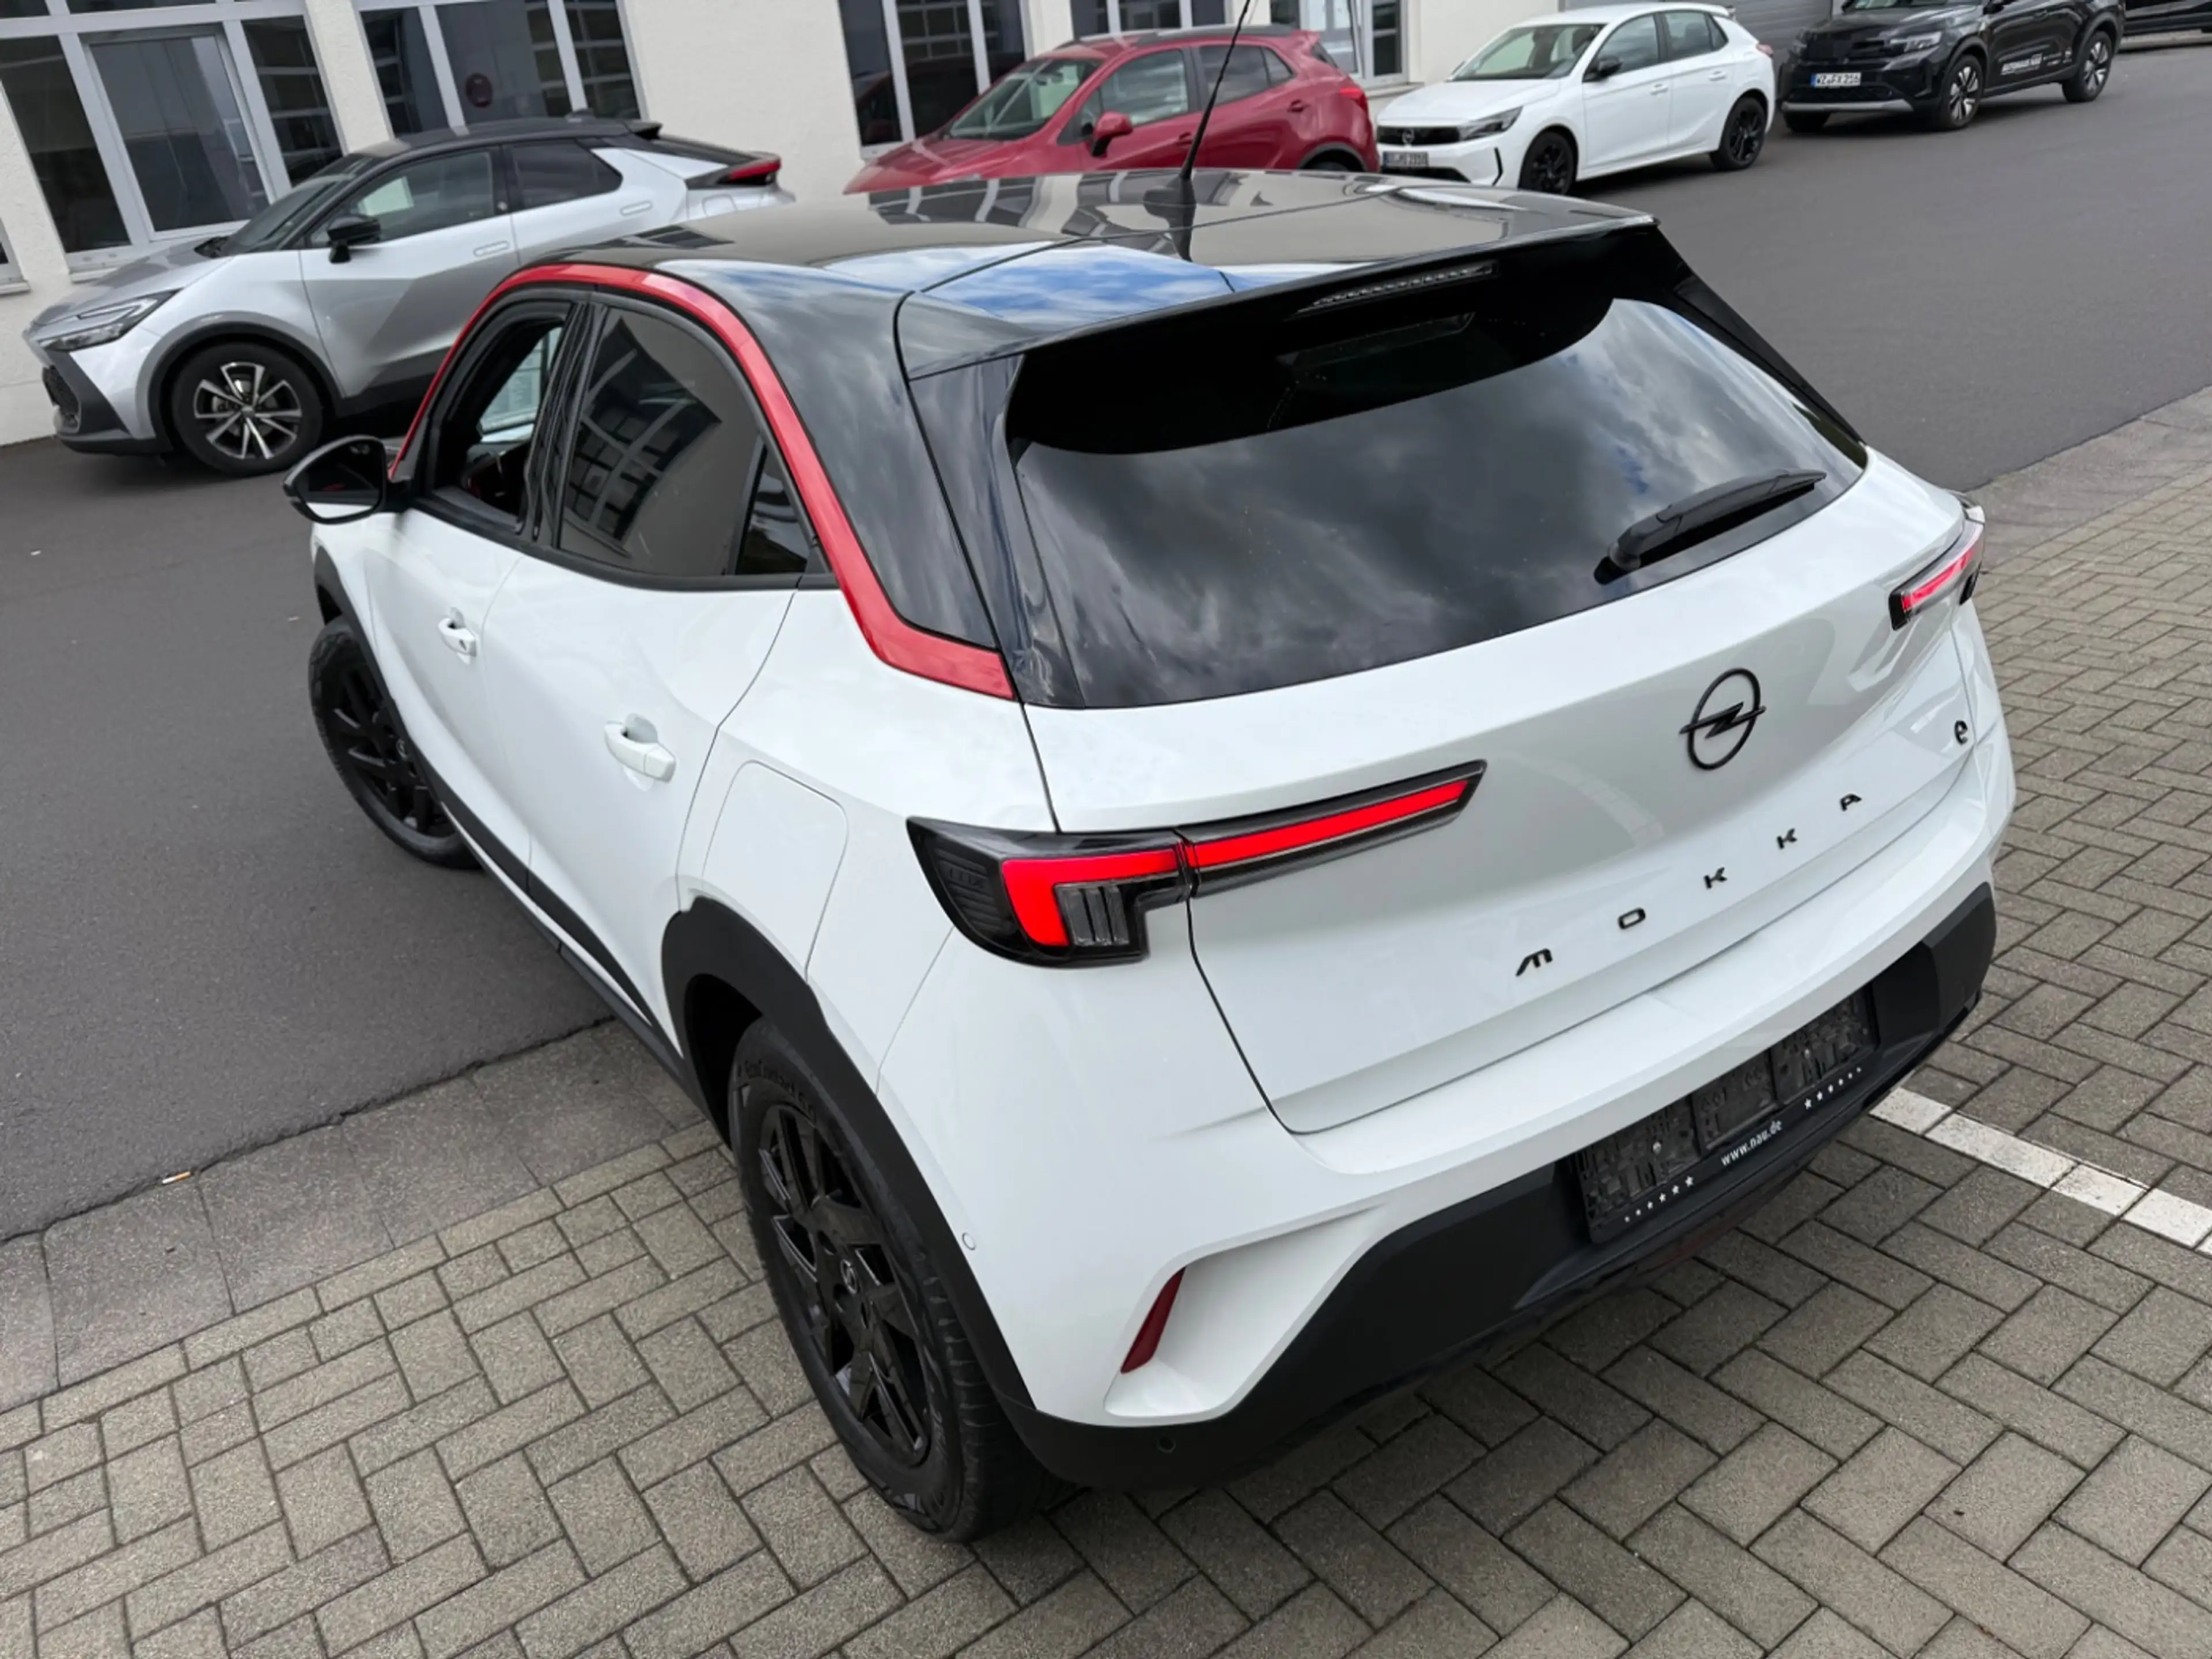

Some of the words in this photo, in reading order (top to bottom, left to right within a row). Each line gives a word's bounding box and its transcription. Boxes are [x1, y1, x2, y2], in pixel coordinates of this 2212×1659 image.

[1954, 719, 1968, 745] e
[1516, 793, 1862, 977] MOKKA
[1720, 1120, 1782, 1166] www.nau.de
